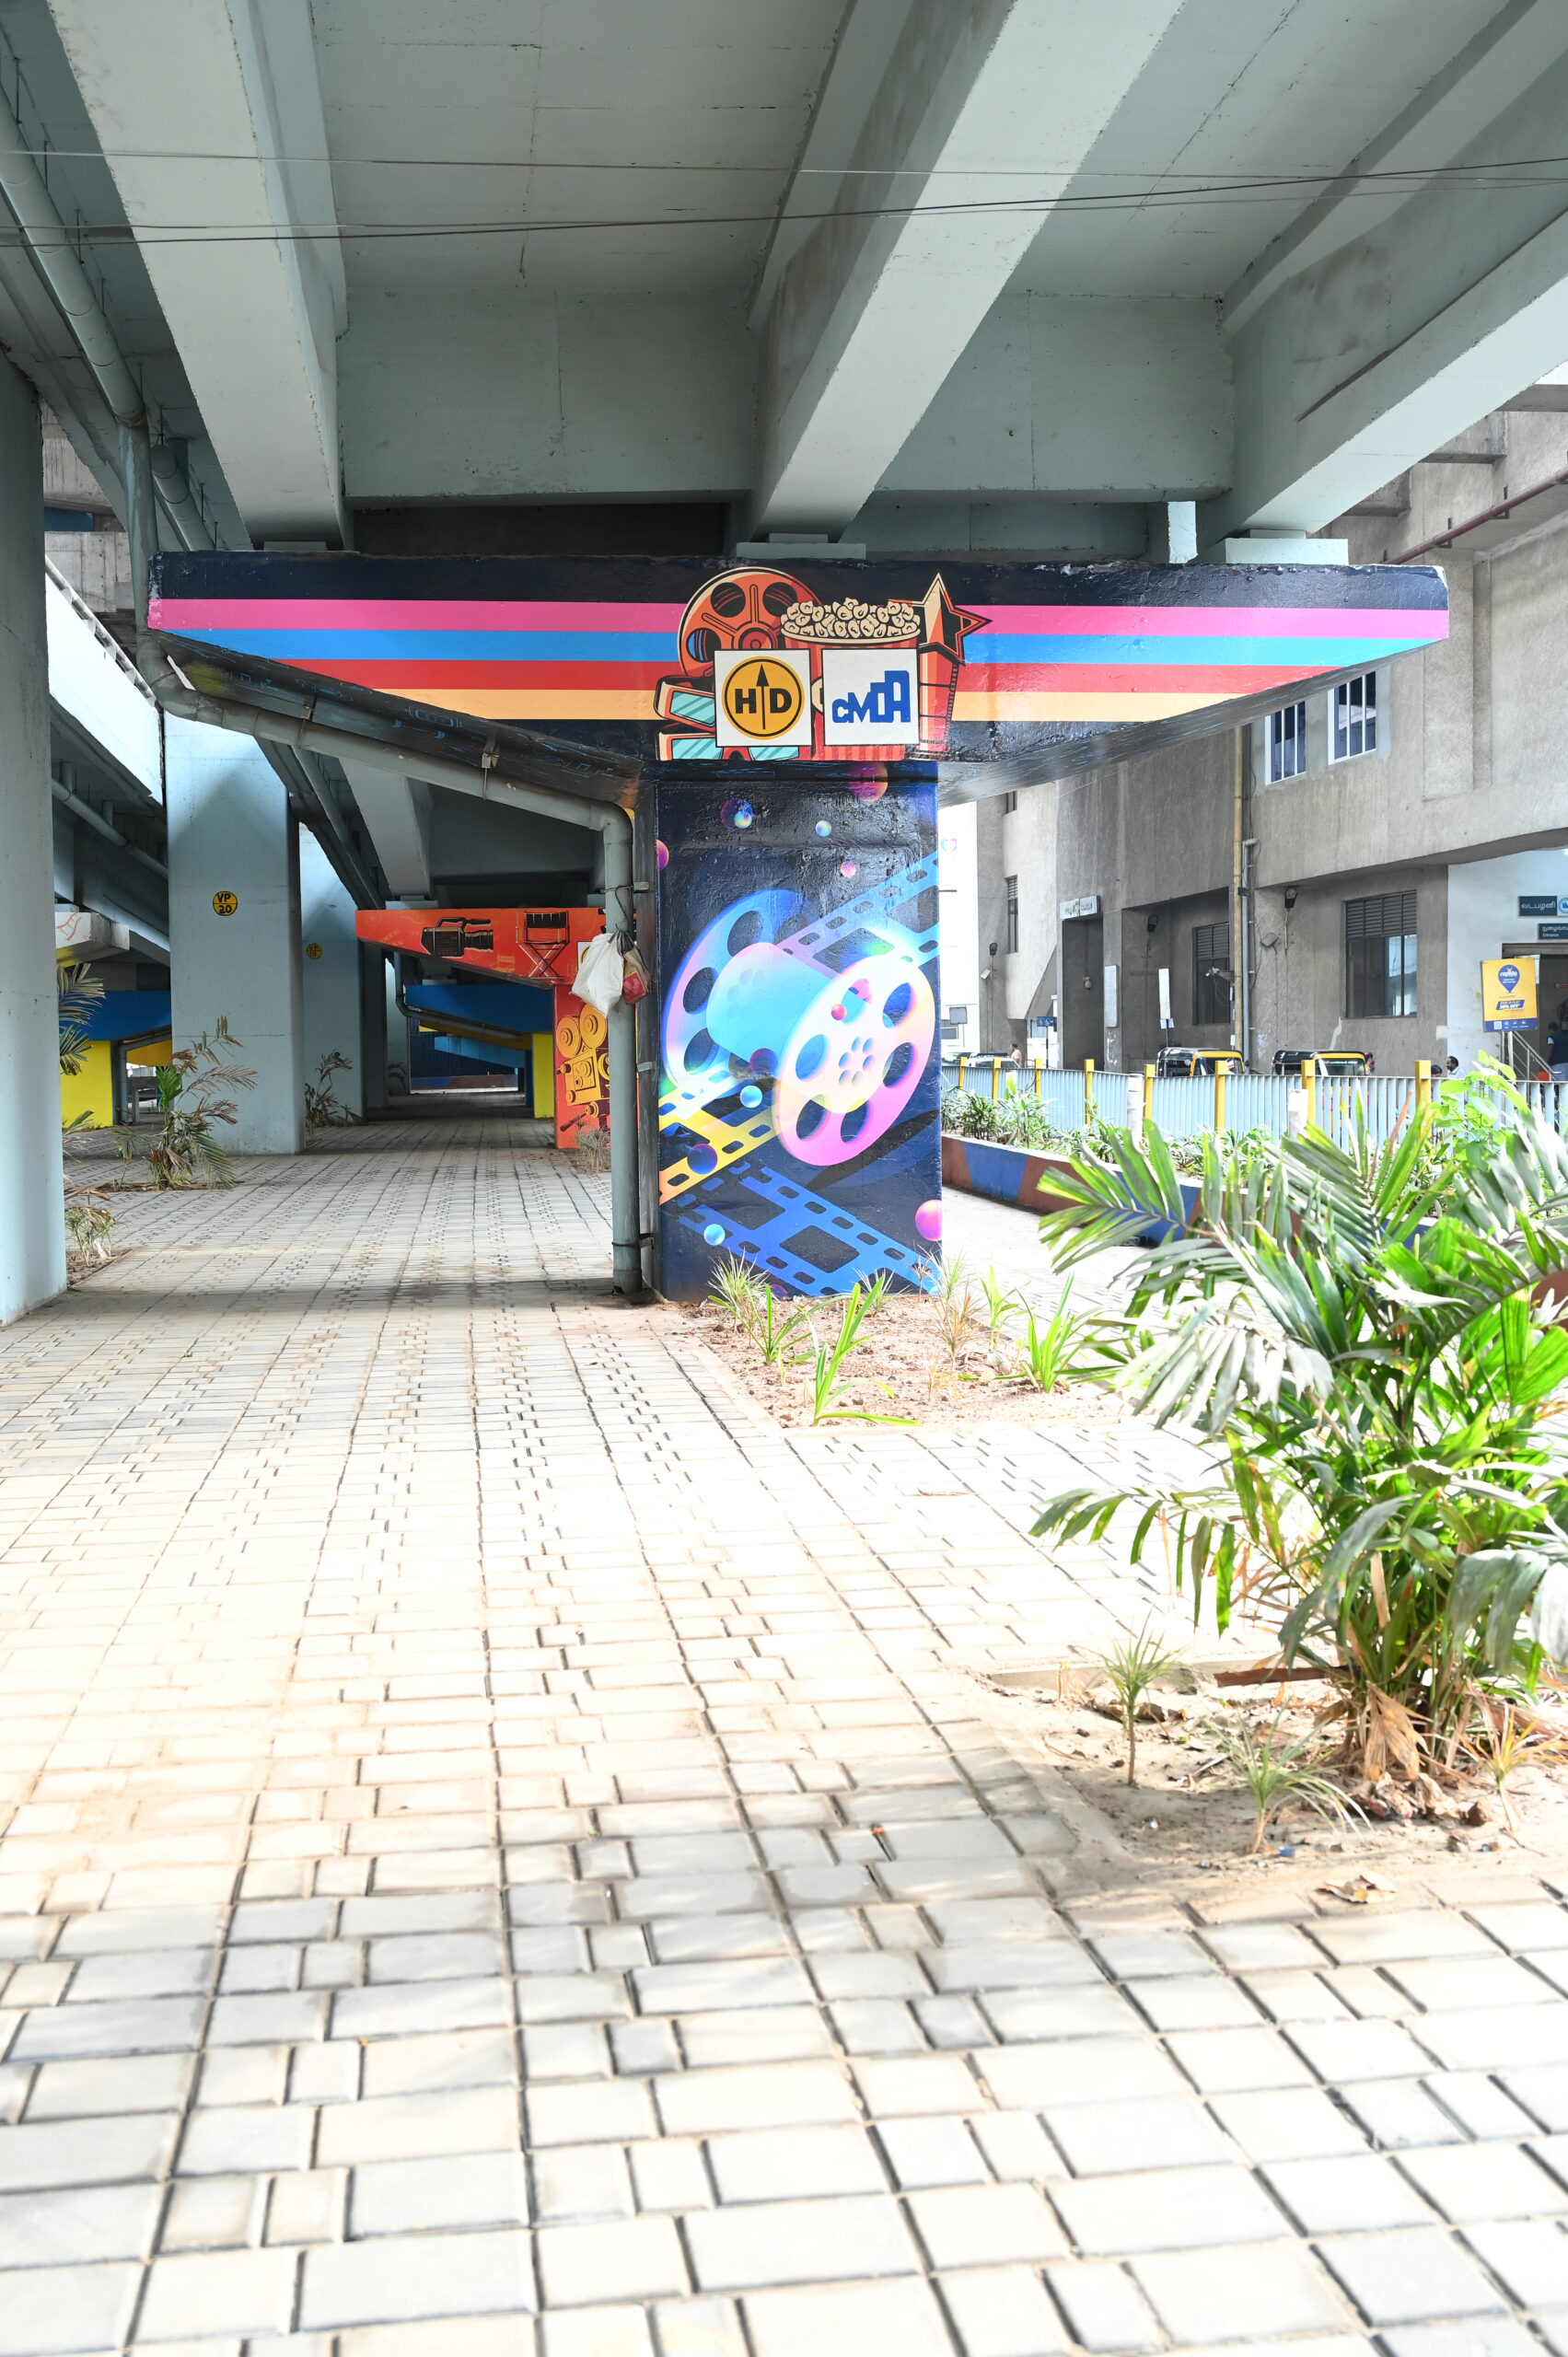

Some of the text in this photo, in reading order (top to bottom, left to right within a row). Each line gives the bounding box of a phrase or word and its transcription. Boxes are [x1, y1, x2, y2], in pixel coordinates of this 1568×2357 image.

[217, 893, 231, 902] VP
[218, 905, 232, 913] 20
[1500, 970, 1518, 978] rapido
